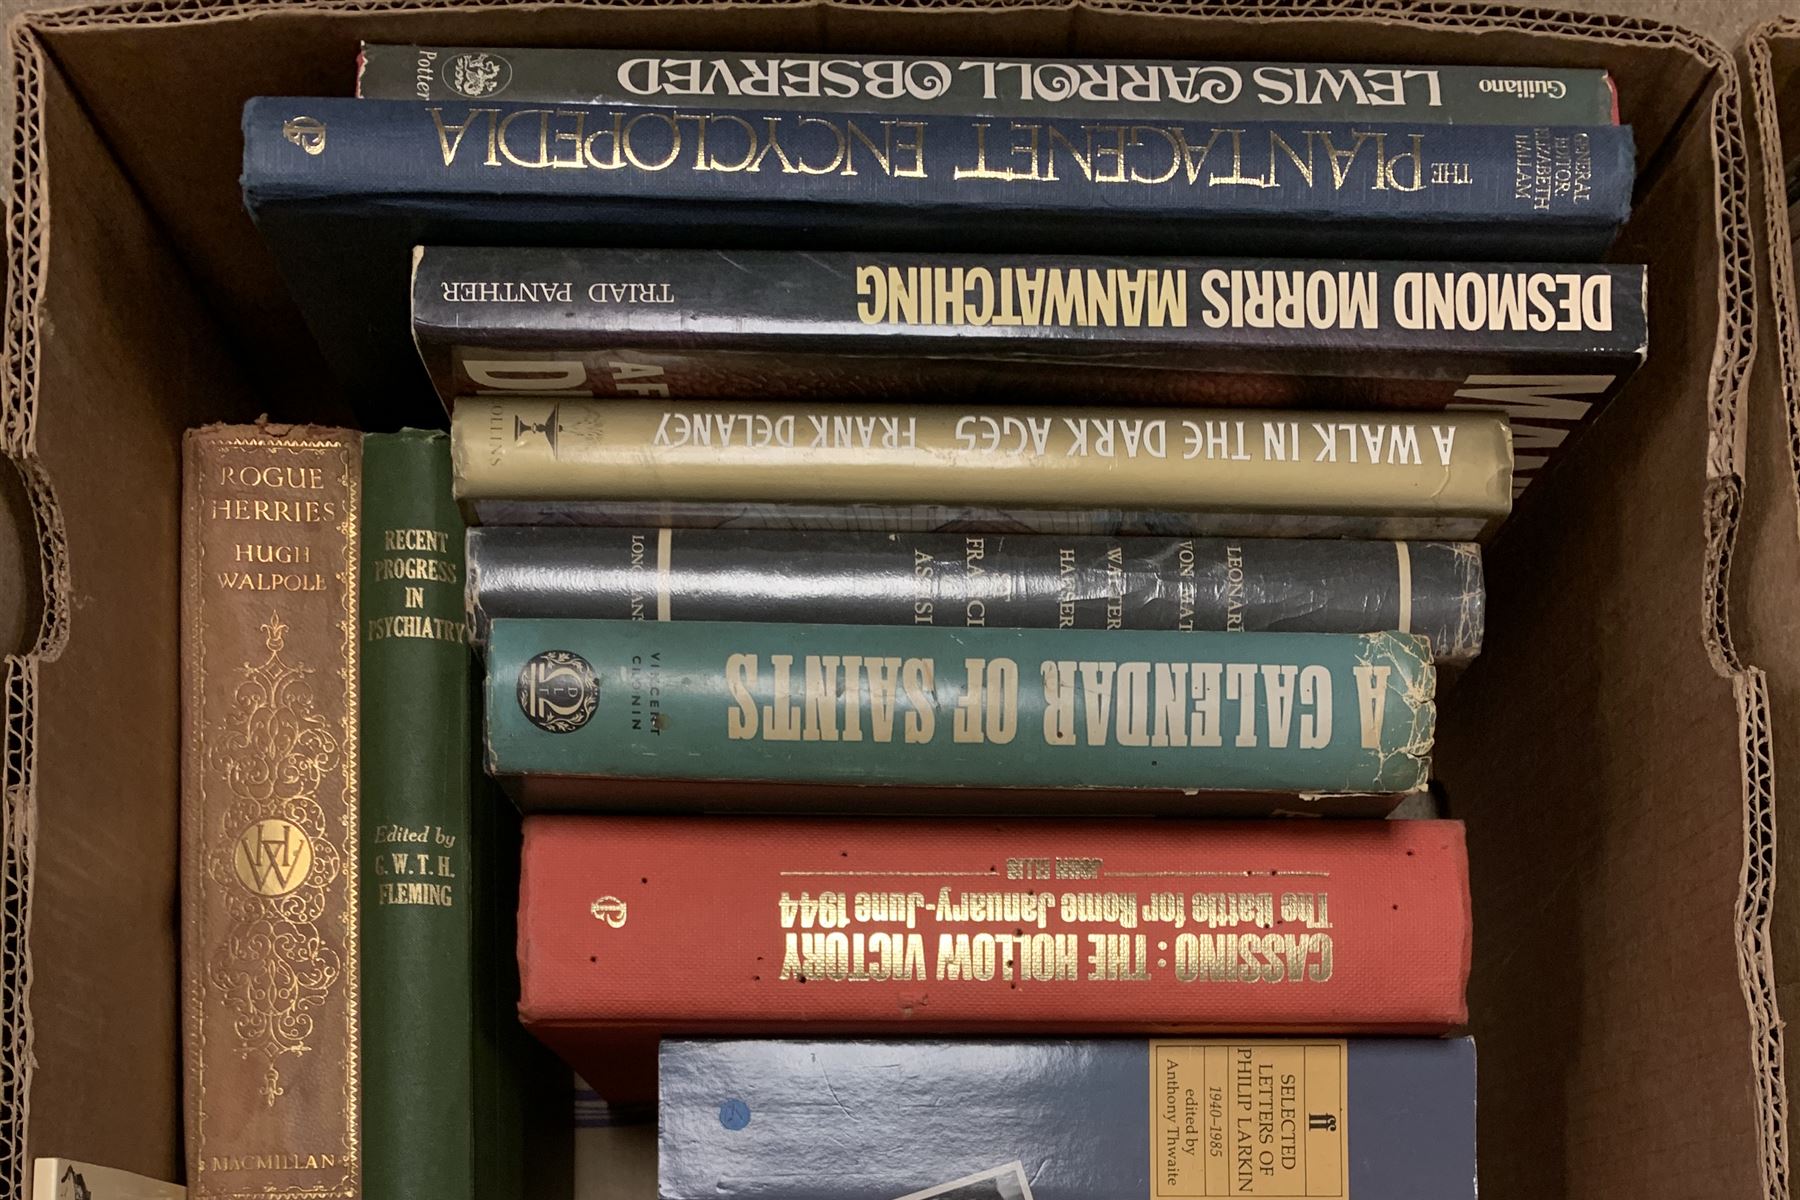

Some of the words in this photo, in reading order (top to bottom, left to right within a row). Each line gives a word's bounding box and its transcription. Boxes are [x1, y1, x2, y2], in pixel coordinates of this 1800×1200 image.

[416, 50, 437, 100] Potter
[617, 57, 951, 99] OBSERVED
[961, 60, 1241, 104] CARROLL
[1254, 66, 1441, 105] LEWIS
[1479, 79, 1567, 98] Guiliano
[425, 107, 926, 178] ENCYCLOPEDIA
[955, 121, 1426, 192] PLANTAGENET
[1431, 162, 1472, 184] THE
[1515, 134, 1532, 199] HALLAM
[1534, 128, 1551, 211] ELIZABETH
[1554, 136, 1571, 197] EDITOR:
[1574, 132, 1592, 205] GENERAL
[441, 281, 573, 303] PANTHER
[588, 282, 675, 303] TRIAD
[856, 266, 1187, 327] MANWATCHING
[1203, 269, 1379, 330] MORRIS
[1393, 273, 1613, 331] DESMOND
[653, 412, 794, 448] DELANEY
[809, 415, 916, 450] FRANK
[955, 415, 1050, 457] AGES
[1067, 418, 1168, 458] DARK
[1182, 420, 1254, 460] THE
[1264, 422, 1300, 462] IN
[1314, 424, 1420, 465] WALK
[1436, 426, 1456, 465] A
[221, 467, 324, 489] ROGUE
[212, 500, 335, 522] HERRIES
[235, 544, 310, 564] HUGH
[385, 530, 448, 554] RECENT
[217, 572, 327, 591] WALPOLE
[375, 558, 456, 584] PROGRESS
[405, 587, 423, 609] IN
[368, 616, 465, 644] PSYCHIATRY
[725, 653, 935, 744] SAINTS
[953, 657, 1018, 745] OF
[1040, 660, 1333, 748] CALENDAR
[1352, 665, 1391, 749] A
[375, 824, 429, 843] Edited
[434, 827, 455, 848] by
[379, 883, 452, 907] FLEMING
[779, 891, 850, 929] 1944
[1060, 893, 1137, 929] Rome
[1142, 892, 1185, 929] for
[1192, 893, 1273, 929] Battle
[1281, 893, 1333, 929] The
[779, 932, 927, 981] VICTORY
[936, 933, 1077, 981] HOLLOW
[1087, 934, 1151, 981] THE
[1163, 1059, 1179, 1123] Anthony
[1237, 1048, 1252, 1111] PHILIP
[1185, 1088, 1198, 1135] edited
[1258, 1063, 1274, 1144] LETTERS
[1280, 1074, 1296, 1170] SELECTED
[213, 1153, 336, 1172] MACMILLAN
[1167, 1127, 1180, 1186] Thwaite
[1182, 1140, 1198, 1156] by
[1237, 1118, 1253, 1193] LARKIN
[1259, 1150, 1274, 1176] OF
